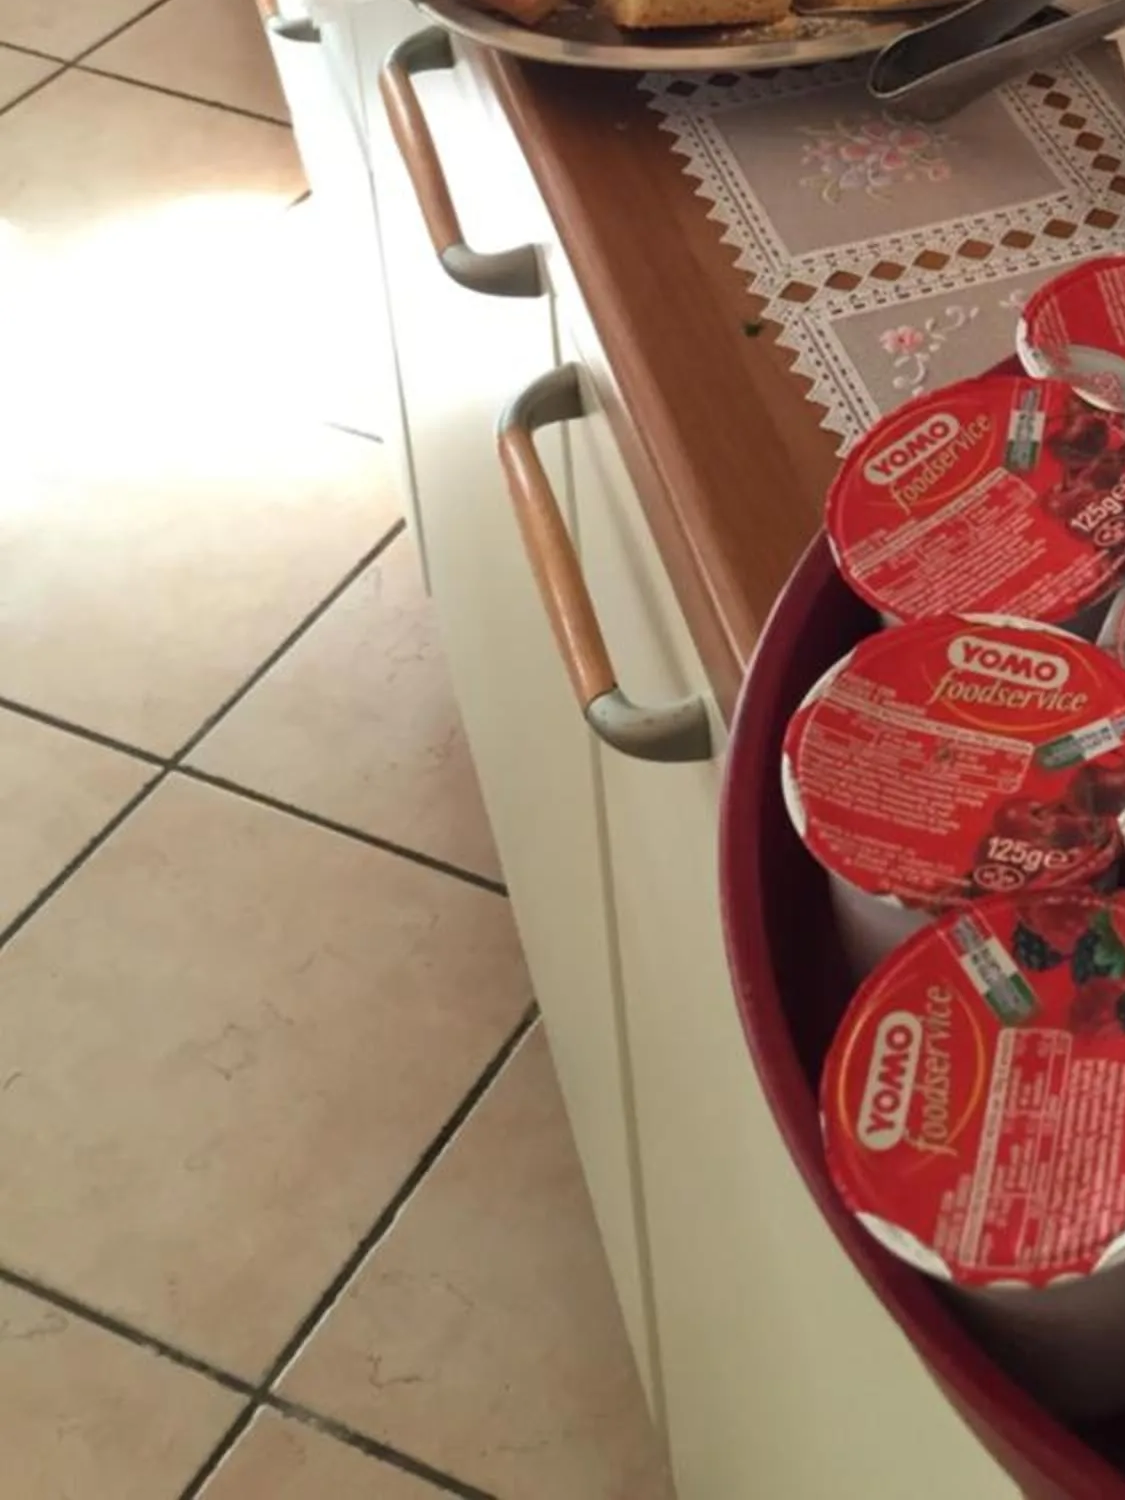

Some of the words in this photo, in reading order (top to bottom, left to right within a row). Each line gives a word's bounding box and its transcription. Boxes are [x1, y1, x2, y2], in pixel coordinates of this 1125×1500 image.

[872, 419, 951, 478] YOMO
[889, 413, 990, 516] foodservice
[926, 668, 1089, 713] foodservice
[960, 640, 1059, 682] YOMO
[865, 1023, 914, 1137] YOMO
[902, 985, 958, 1157] foodservice
